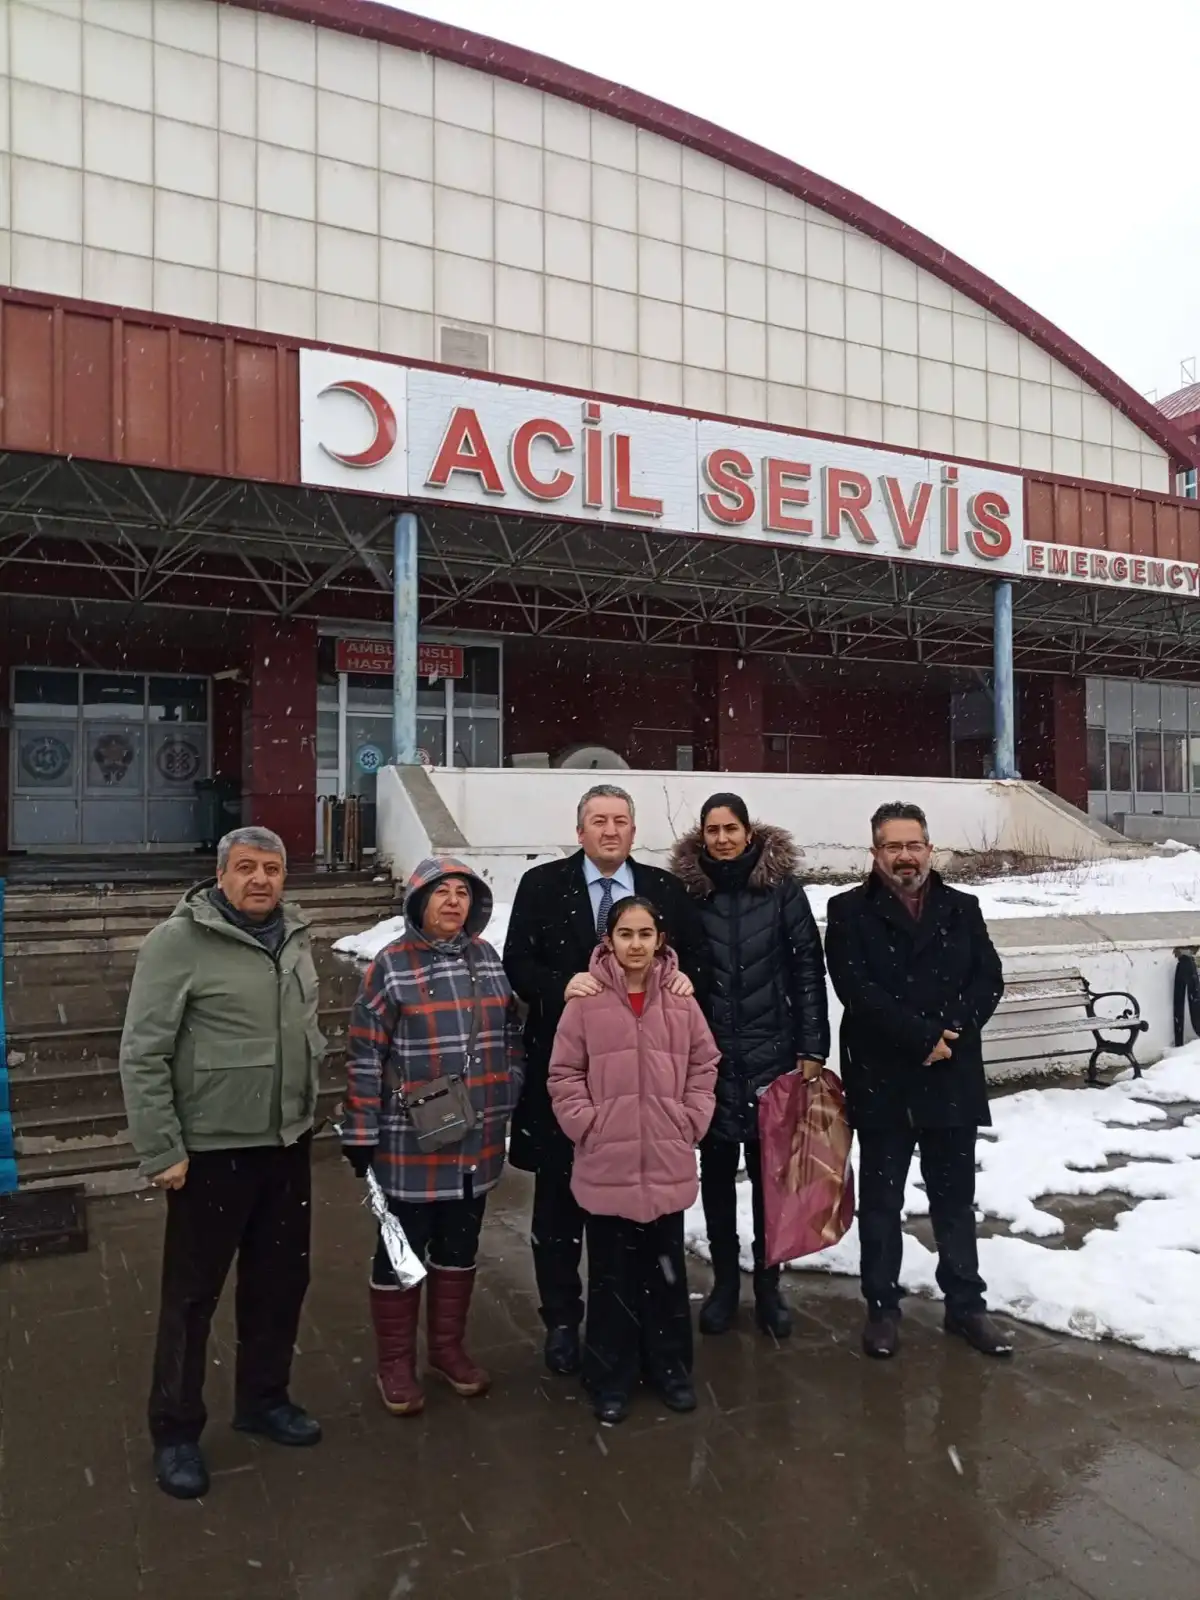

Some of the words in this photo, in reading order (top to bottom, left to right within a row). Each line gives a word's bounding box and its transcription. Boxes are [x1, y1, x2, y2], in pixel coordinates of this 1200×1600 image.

[424, 401, 663, 518] ACİL
[701, 449, 1013, 561] SERVİS
[1027, 545, 1200, 592] EMERGENCY
[346, 643, 454, 659] AMBUNSLI
[347, 658, 395, 671] HAST
